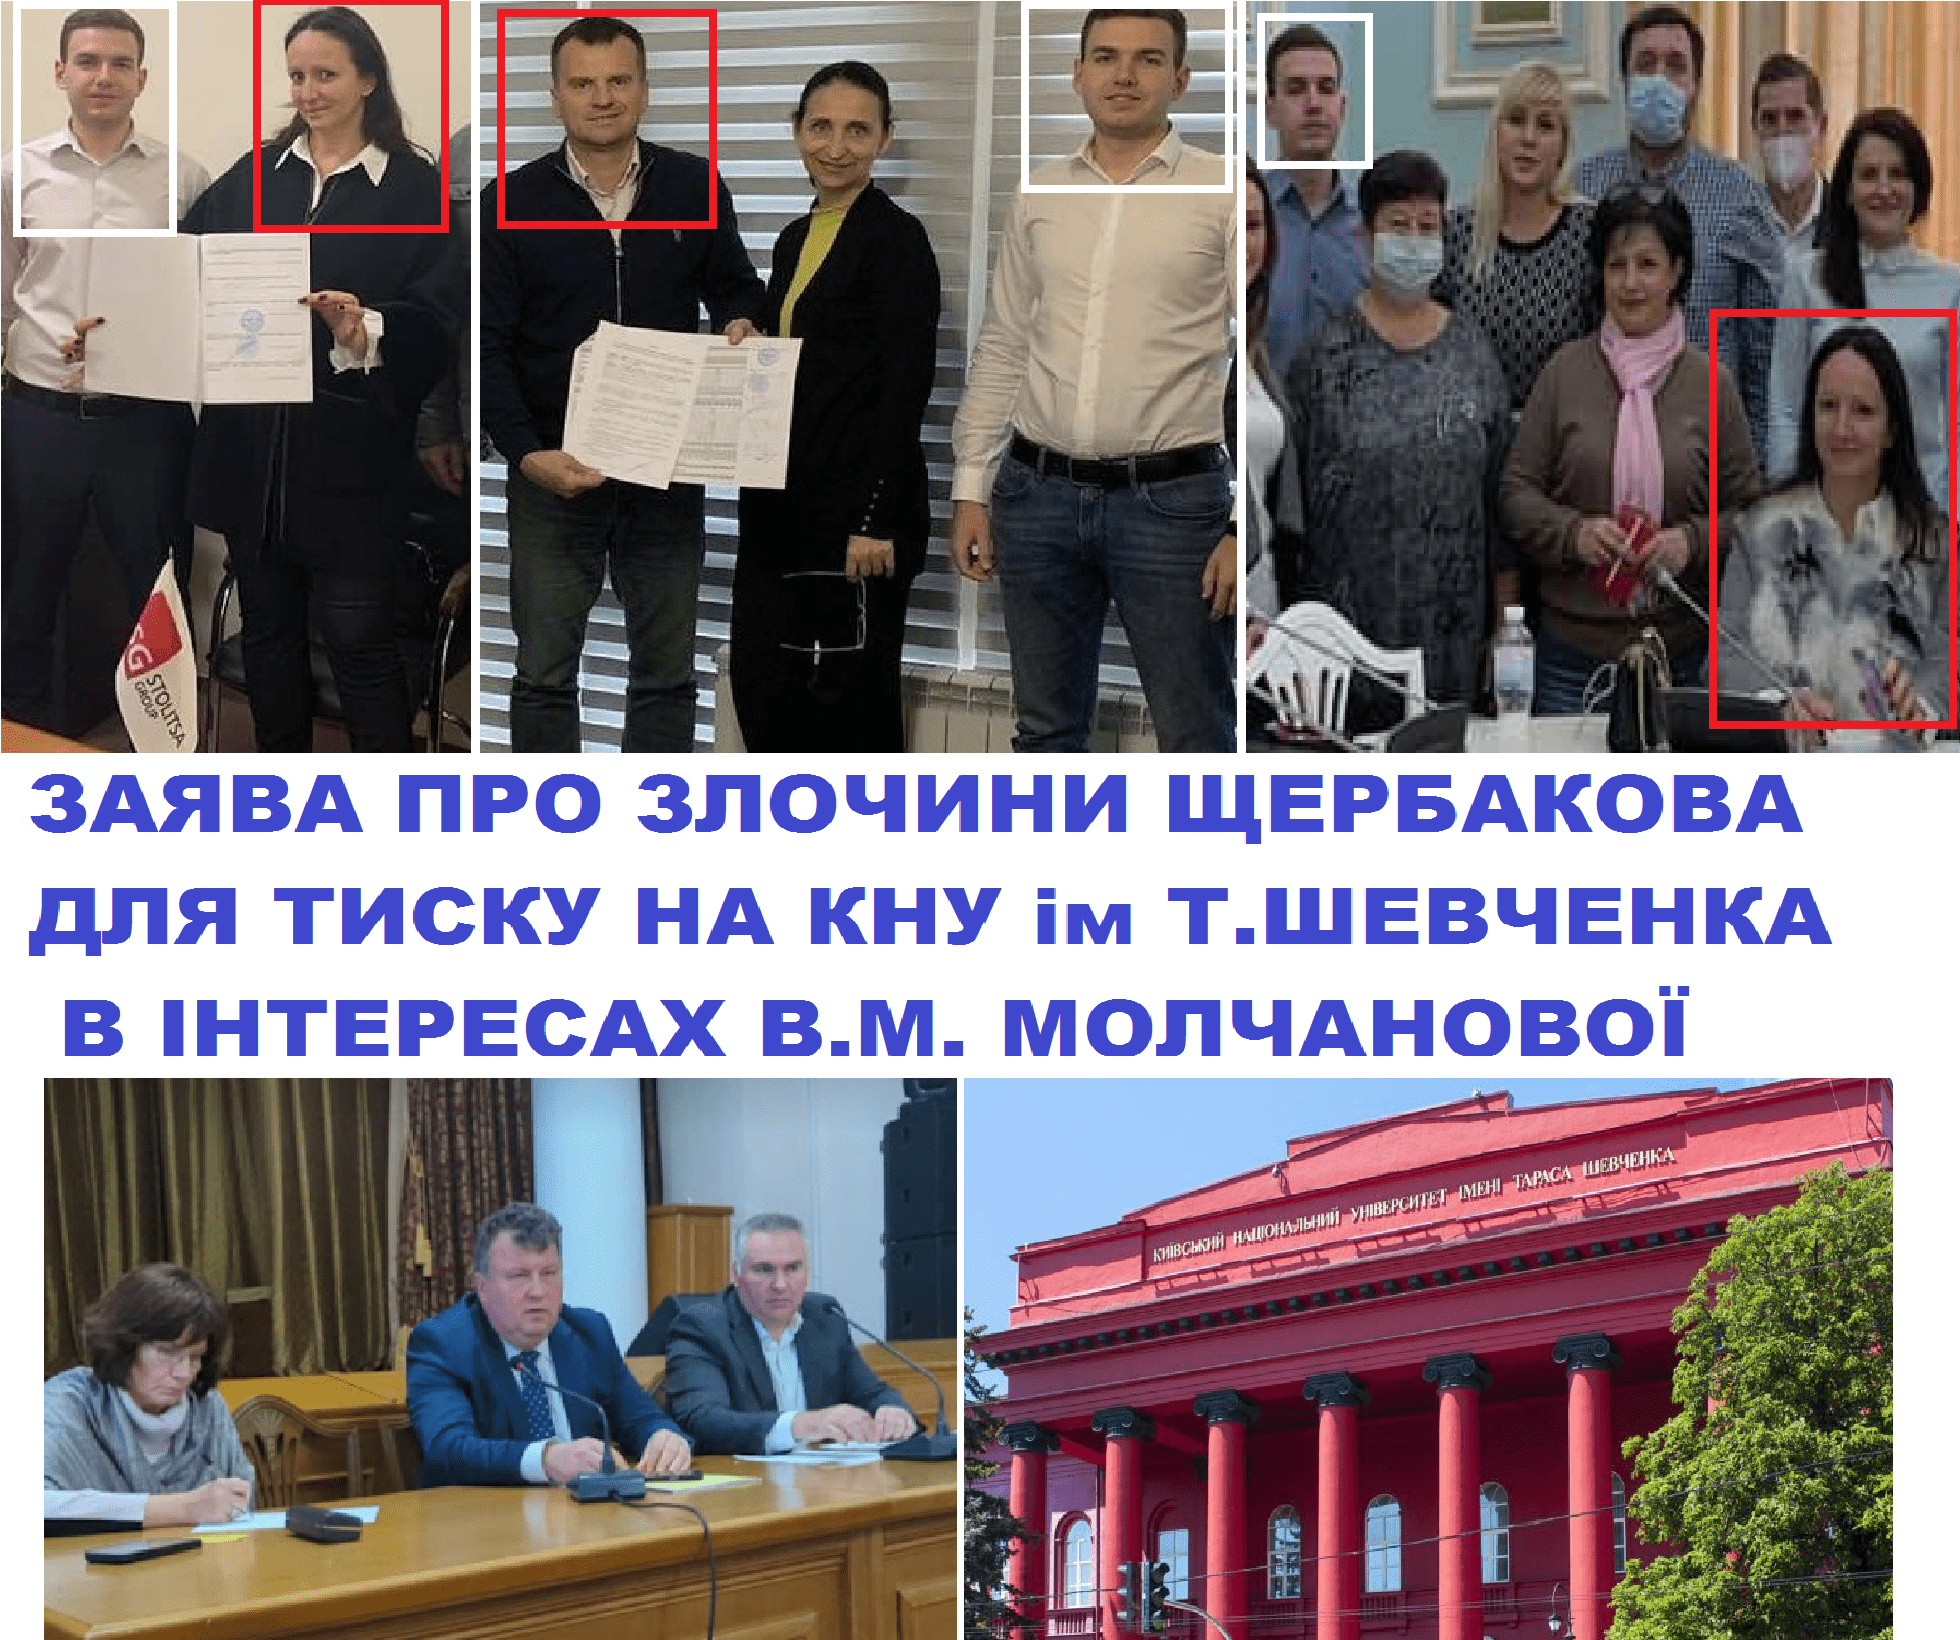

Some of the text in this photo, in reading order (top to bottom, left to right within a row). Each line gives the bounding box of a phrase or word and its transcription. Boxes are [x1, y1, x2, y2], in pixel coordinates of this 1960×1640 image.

[134, 681, 158, 719] GROUP
[146, 673, 186, 748] STOLITSA
[1153, 1147, 1676, 1263] КИЇВСЬКИЙ НАЦІОНАЛЬНИЙ УНІВЕРСИТЕТ ІМЕНІ ТАРАСА ШЕВЧЕНКА
